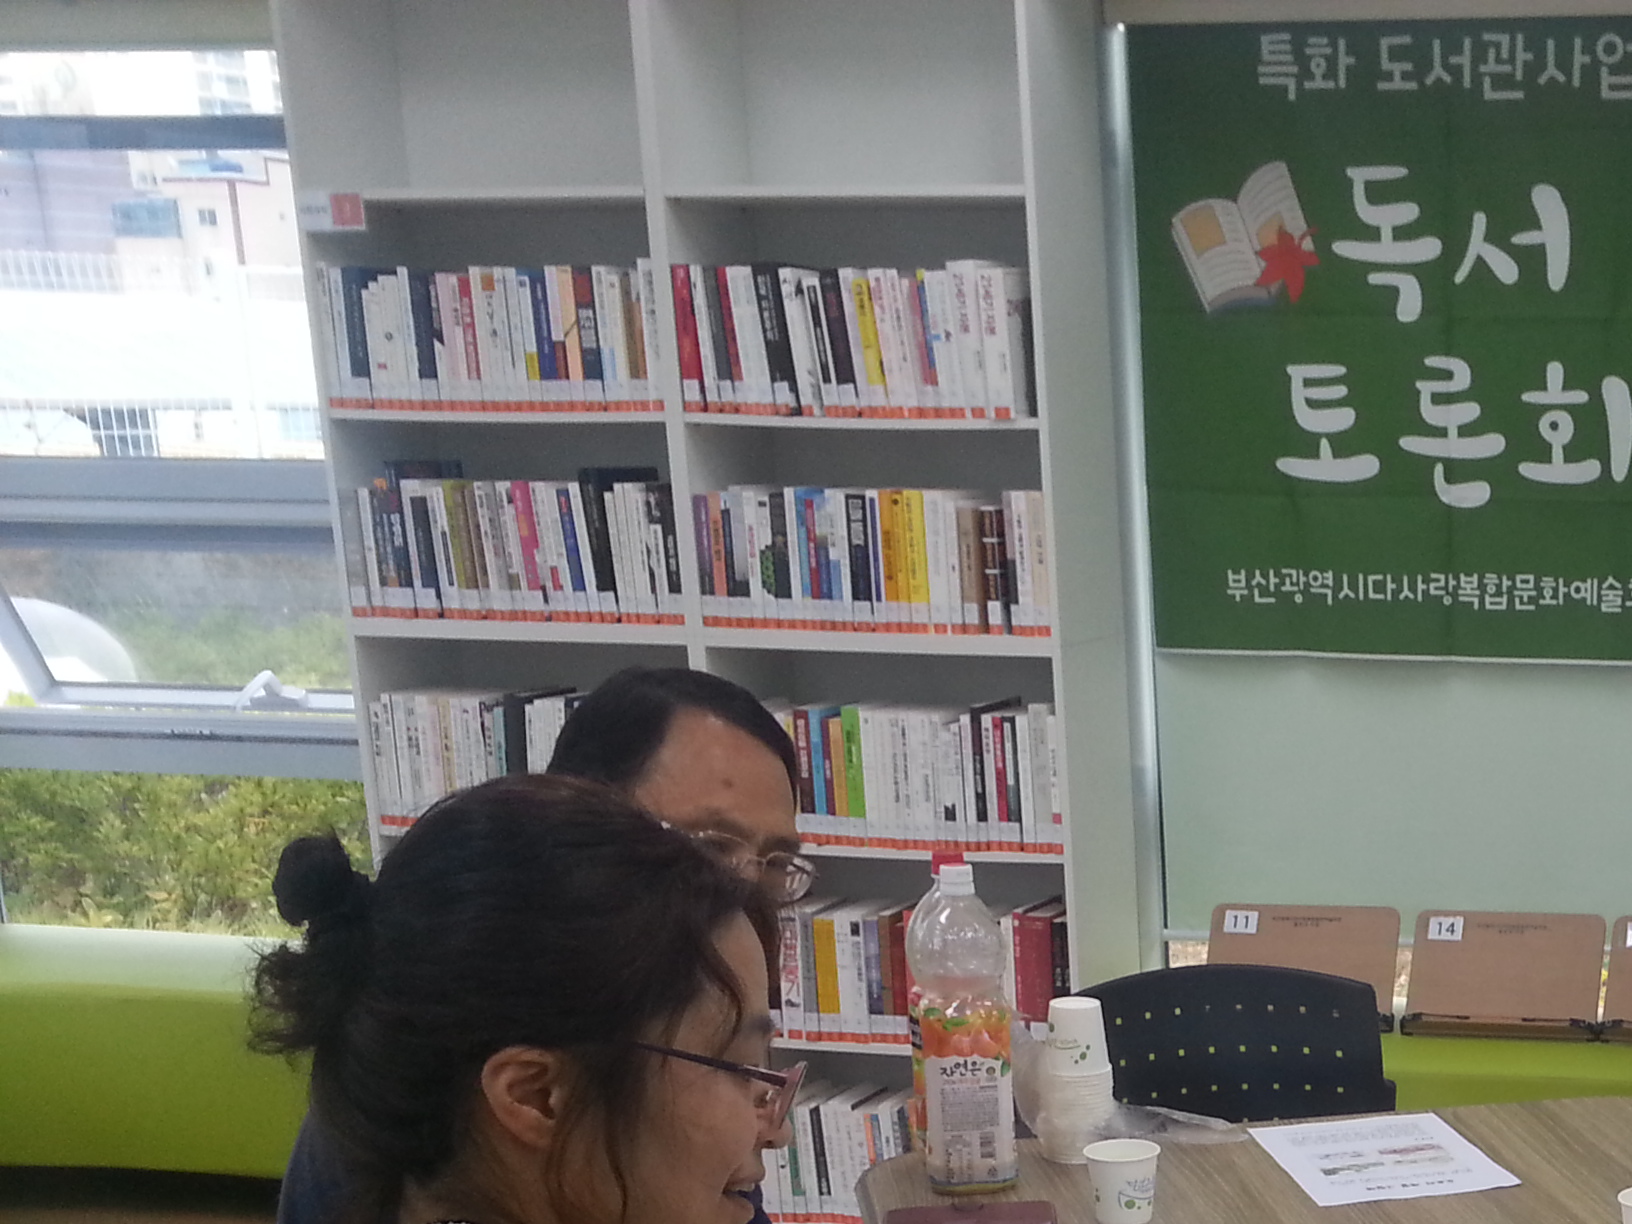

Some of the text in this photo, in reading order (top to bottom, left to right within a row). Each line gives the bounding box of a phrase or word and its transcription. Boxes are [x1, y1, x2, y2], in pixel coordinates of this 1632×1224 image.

[1257, 32, 1355, 99] 특화
[1331, 165, 1572, 322] 독서
[1231, 912, 1251, 931] 11
[1435, 919, 1457, 938] 14
[940, 1059, 982, 1077] 자연은
